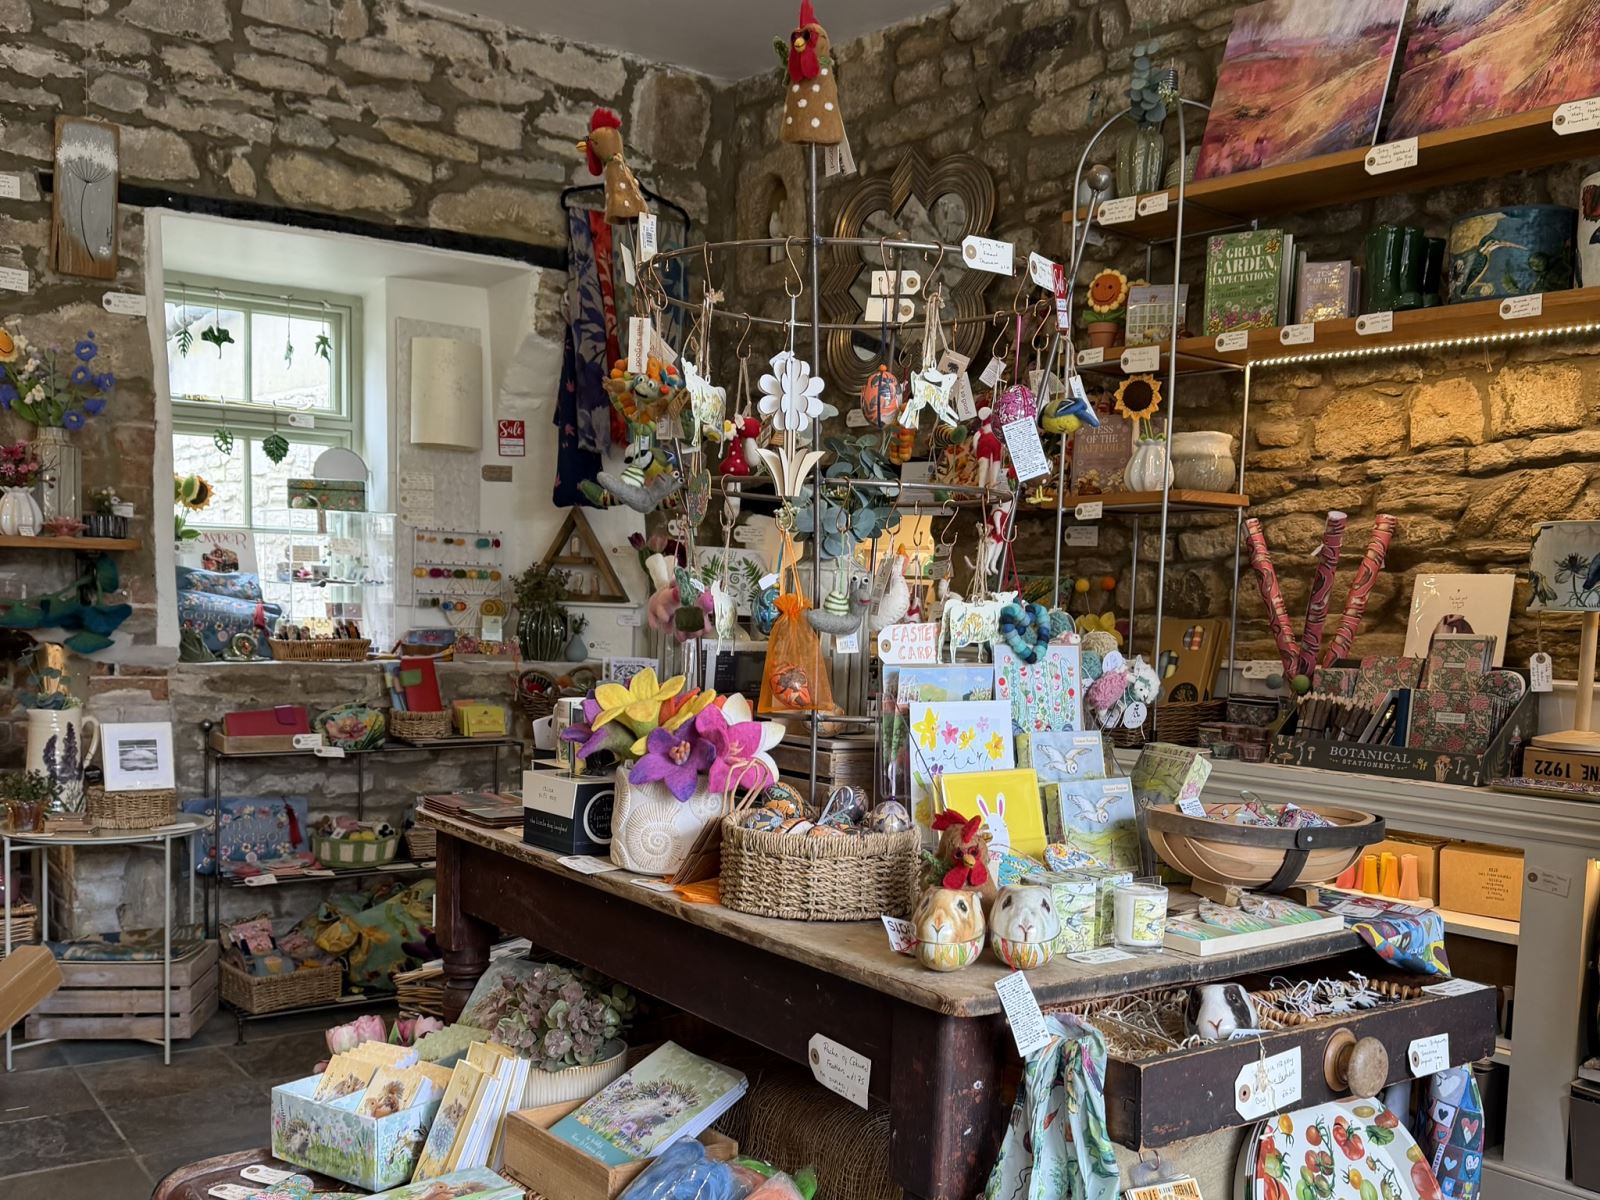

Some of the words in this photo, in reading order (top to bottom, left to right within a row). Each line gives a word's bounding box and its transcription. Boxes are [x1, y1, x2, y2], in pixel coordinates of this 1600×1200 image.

[1225, 244, 1264, 259] GREAT
[1213, 255, 1275, 275] GARDEN
[1212, 271, 1275, 286] EXPECTATIONS
[500, 420, 522, 437] Sale
[1092, 425, 1114, 435] TESS
[1086, 435, 1099, 444] OF
[1101, 434, 1118, 443] THE
[897, 645, 937, 660] CARD
[1330, 746, 1411, 764] BOTANICAL
[1342, 759, 1396, 770] STATIONERY
[1534, 760, 1571, 779] 1922
[1580, 764, 1600, 782] NE
